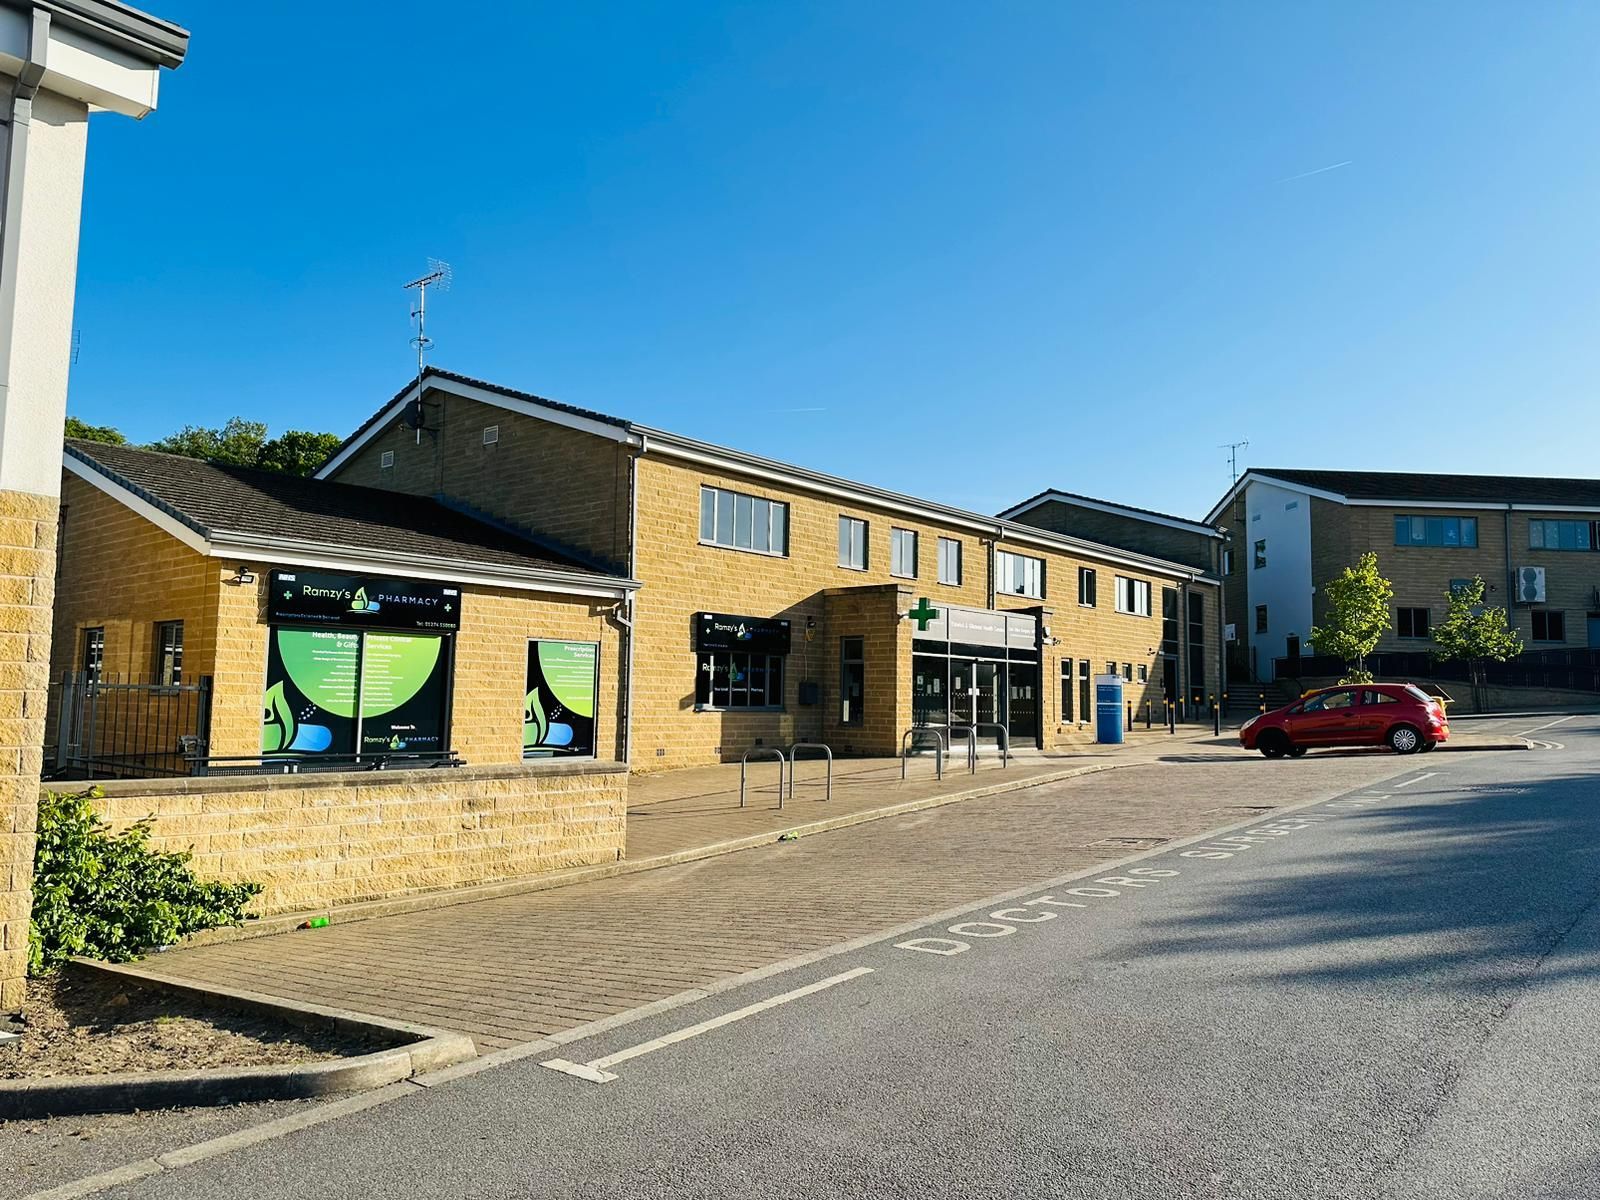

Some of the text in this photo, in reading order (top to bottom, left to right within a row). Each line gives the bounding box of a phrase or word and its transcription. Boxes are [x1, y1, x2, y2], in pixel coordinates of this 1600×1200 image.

[302, 585, 439, 606] Ramzy's PHARMACY
[714, 622, 738, 633] Ramzy's
[364, 735, 391, 744] Ramzy's
[892, 867, 1181, 956] DOCTORS
[1180, 813, 1337, 860] SURGERY
